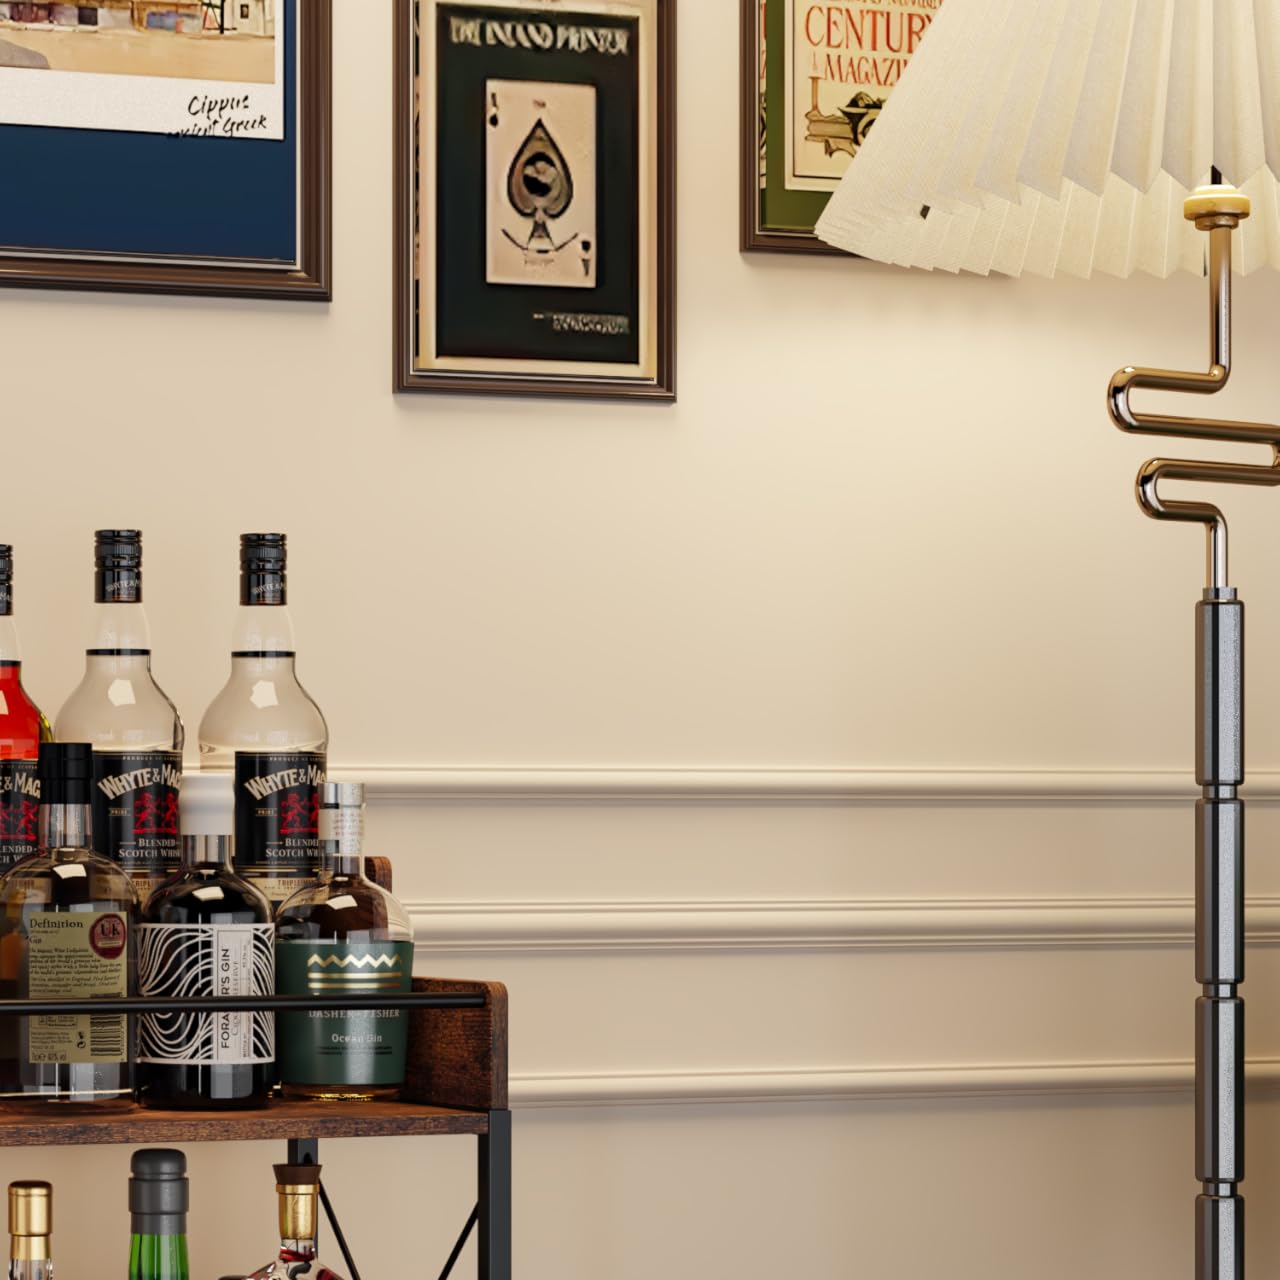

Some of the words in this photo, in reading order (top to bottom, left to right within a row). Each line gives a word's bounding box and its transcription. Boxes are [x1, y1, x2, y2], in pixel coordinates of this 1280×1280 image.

[824, 53, 908, 87] MAGAZI
[97, 767, 153, 800] WHYTE
[244, 768, 300, 801] WHYTE
[119, 848, 158, 858] SCOTCH
[265, 848, 304, 857] SCOTCH
[29, 918, 83, 930] Definition
[221, 948, 231, 972] GIN
[221, 976, 232, 1049] FORAR'S
